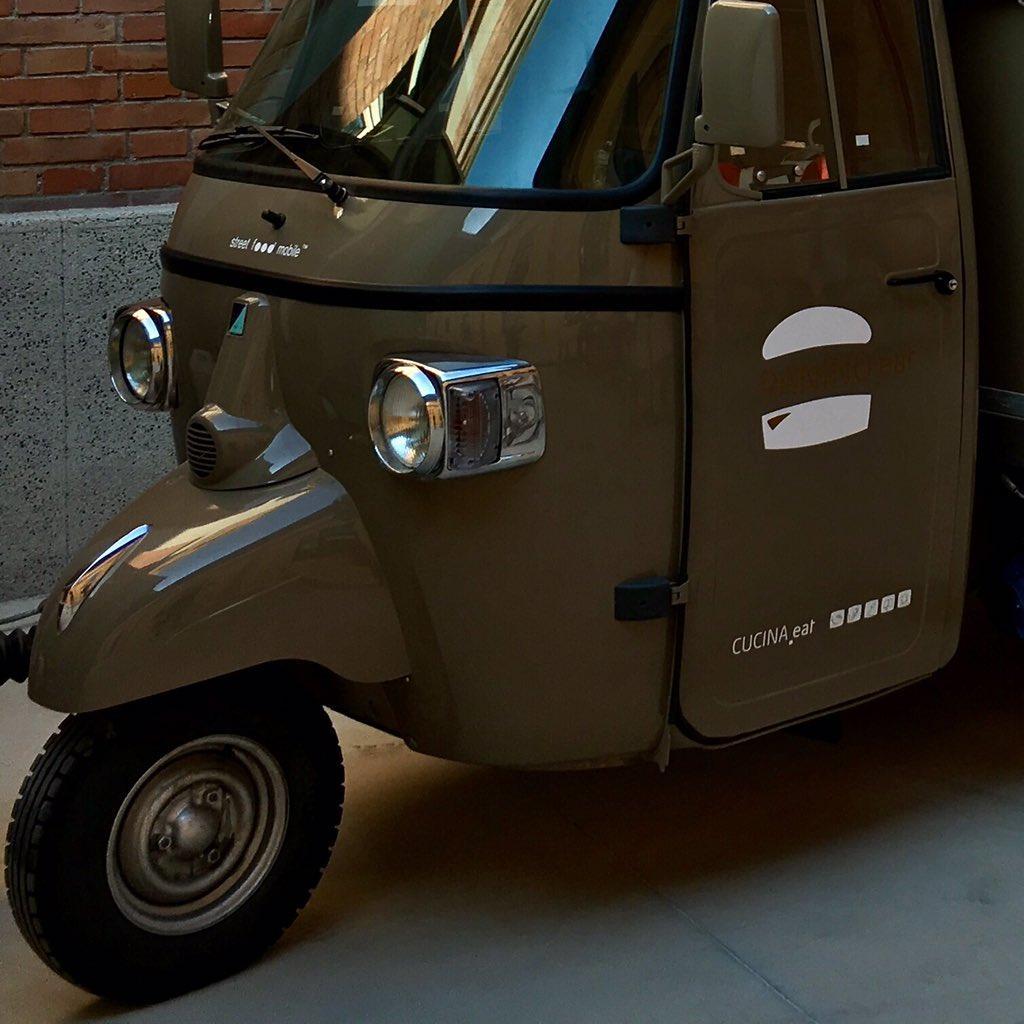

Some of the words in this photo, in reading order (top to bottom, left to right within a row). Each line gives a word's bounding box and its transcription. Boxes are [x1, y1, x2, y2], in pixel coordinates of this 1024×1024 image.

[229, 236, 251, 250] street
[251, 238, 277, 254] food
[732, 619, 815, 655] CUCINA.eat
